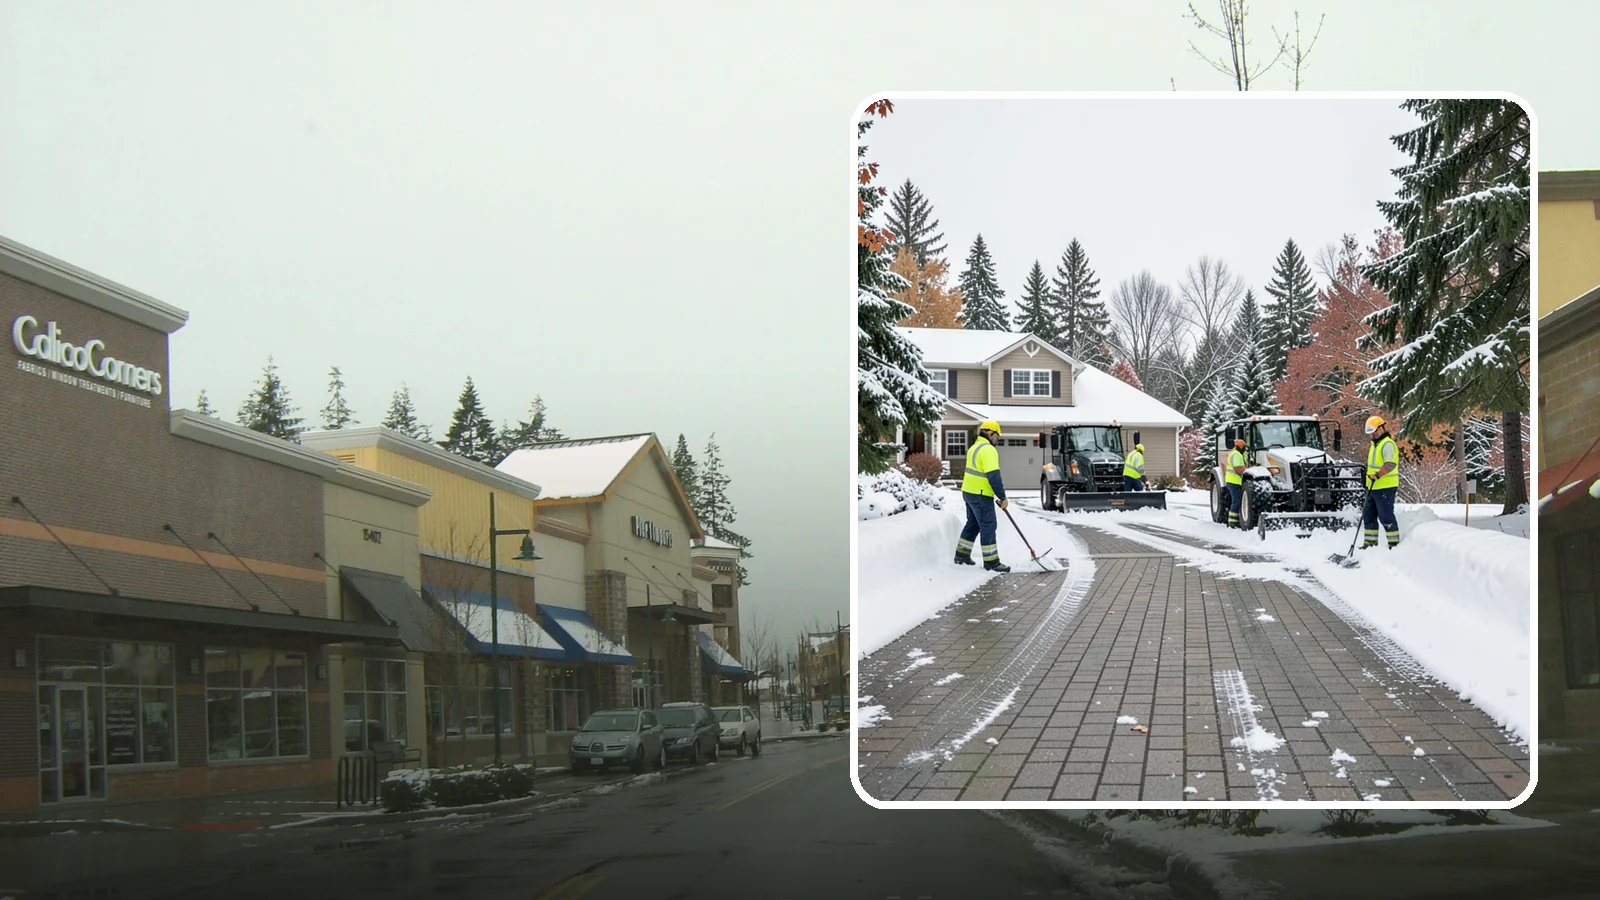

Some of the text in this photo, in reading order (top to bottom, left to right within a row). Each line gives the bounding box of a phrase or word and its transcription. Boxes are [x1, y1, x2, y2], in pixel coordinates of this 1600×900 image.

[16, 360, 47, 378] FABRICS
[51, 370, 78, 387] WINDOW
[79, 379, 117, 398] TREATMENTS
